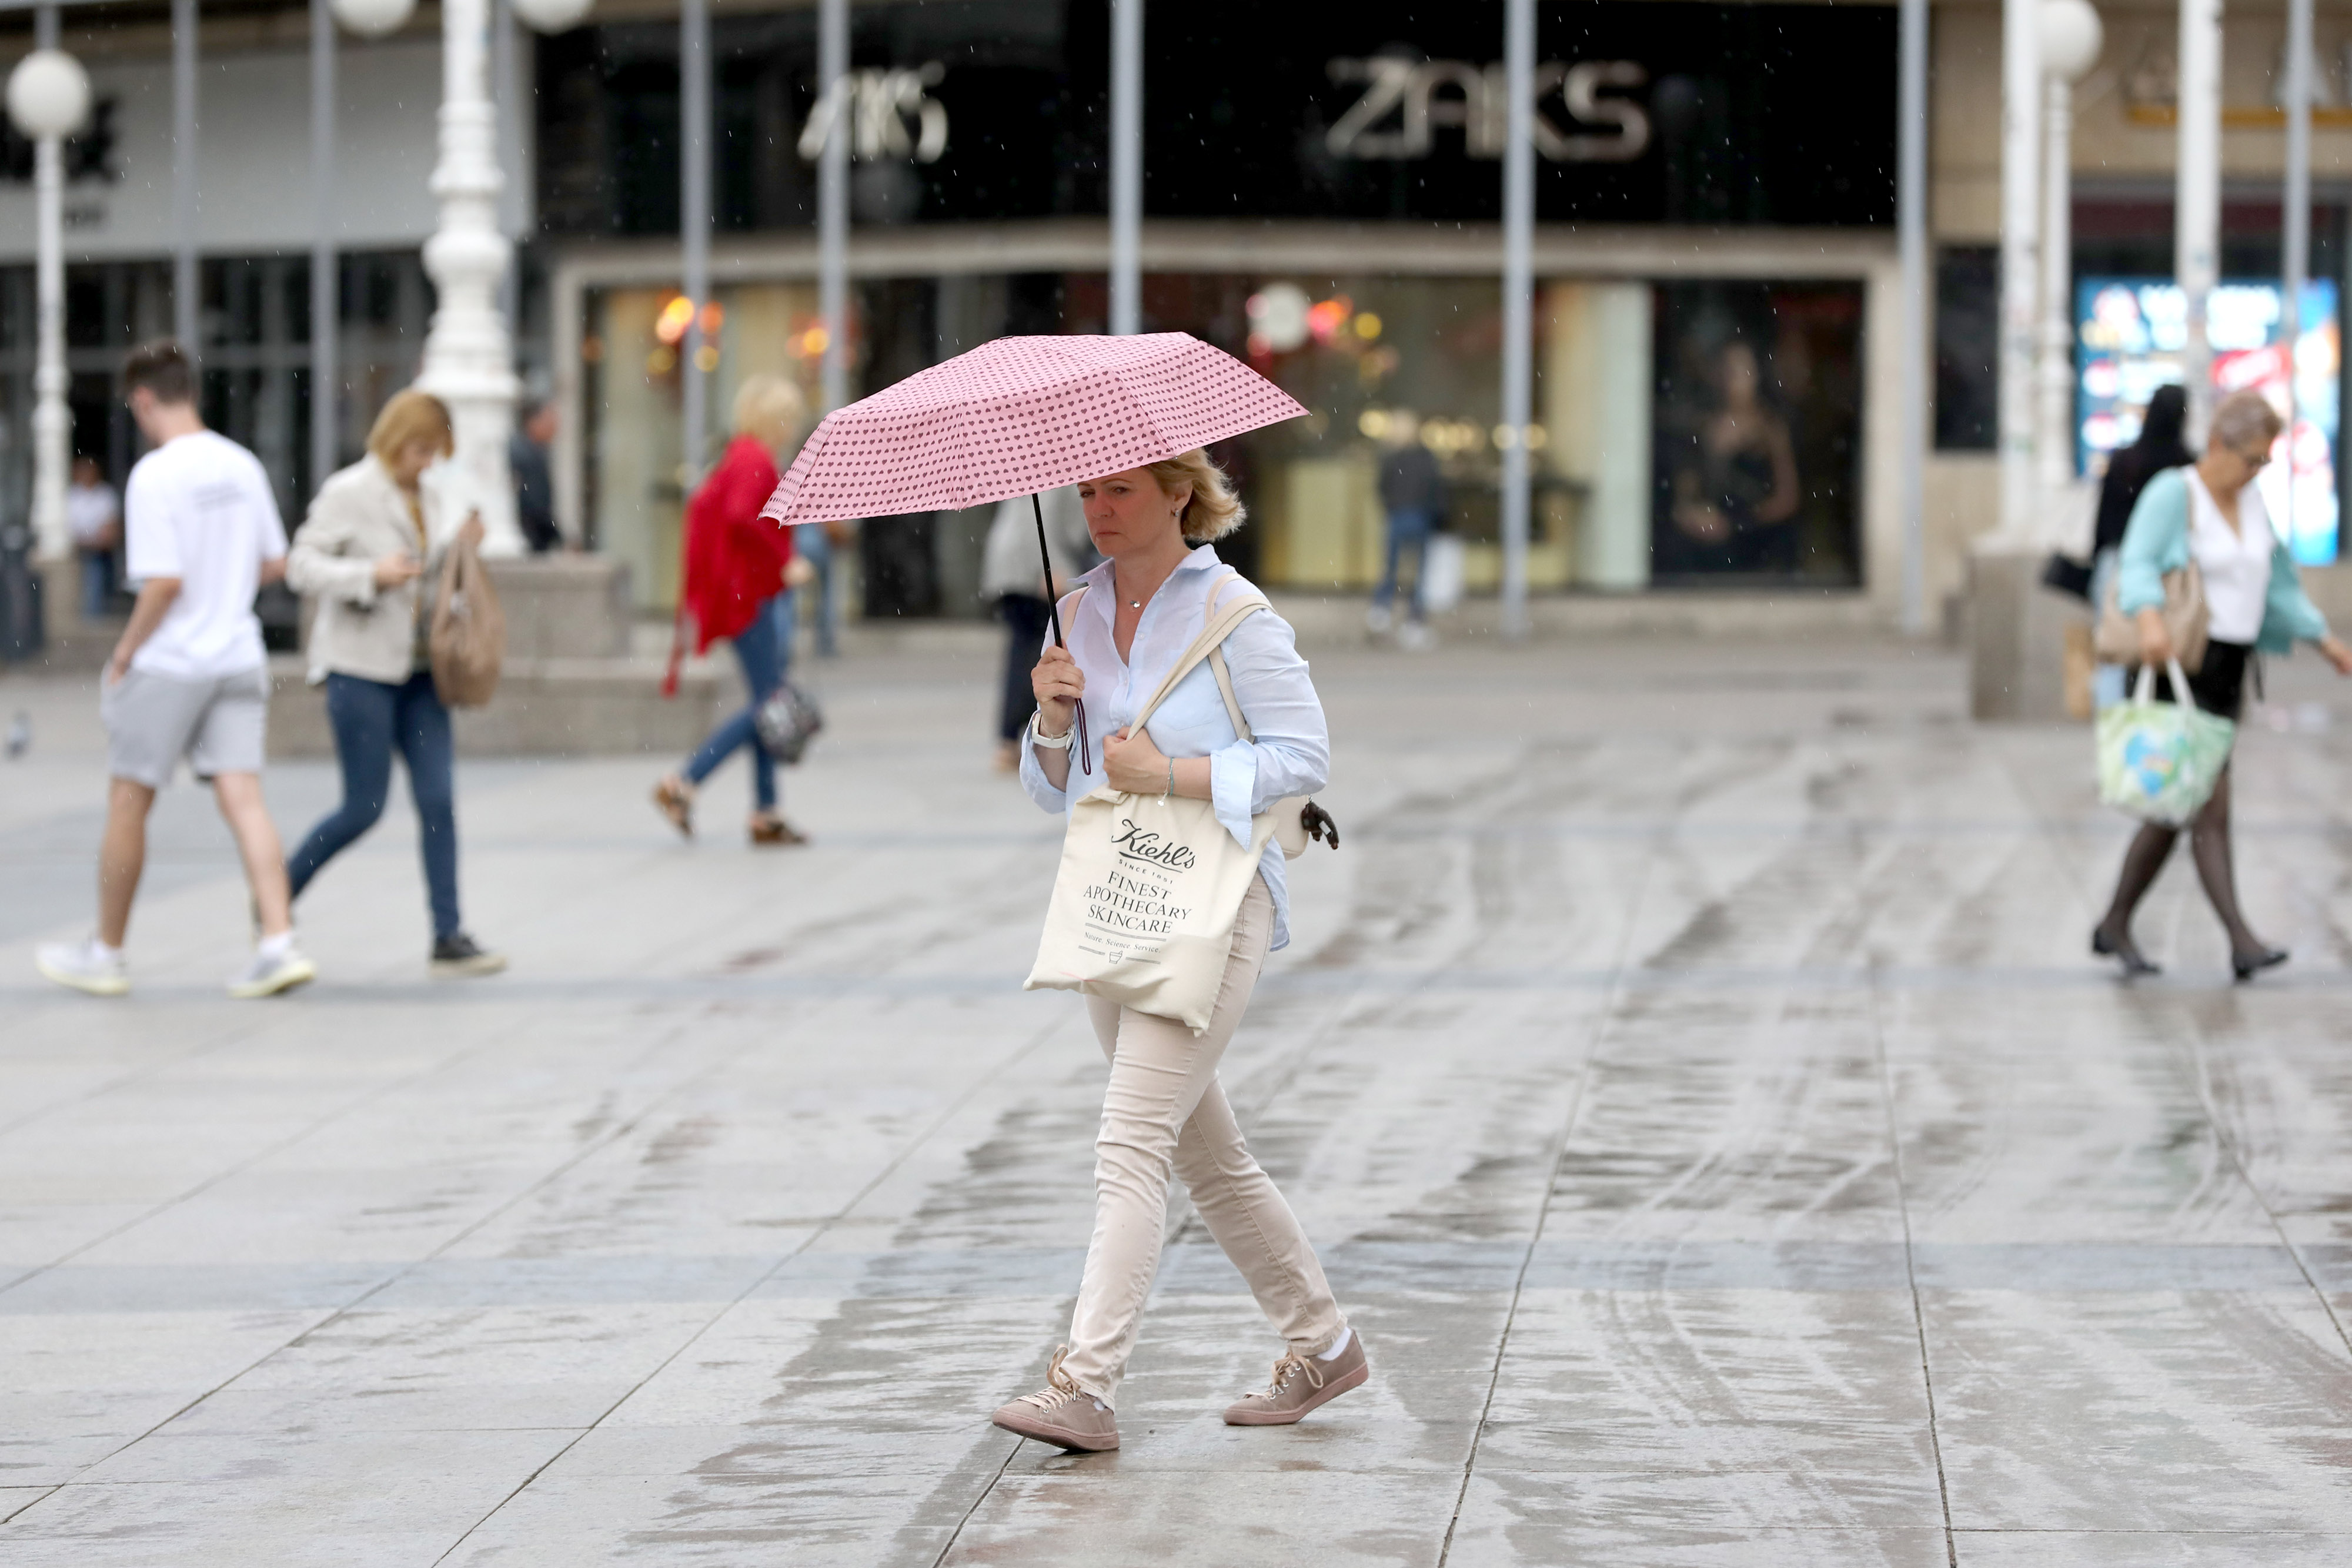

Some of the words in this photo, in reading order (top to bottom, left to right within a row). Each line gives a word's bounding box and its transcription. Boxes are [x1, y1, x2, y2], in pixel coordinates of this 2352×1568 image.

[1111, 819, 1196, 869] Kiehl's
[1118, 858, 1147, 874] SINCE
[1107, 870, 1172, 900] FINEST
[1083, 884, 1192, 920] APOTHECARY
[1088, 904, 1173, 934] SKINCARE
[1084, 931, 1104, 944] Nature.
[1105, 938, 1132, 950] Science.
[1134, 944, 1161, 954] Service.
